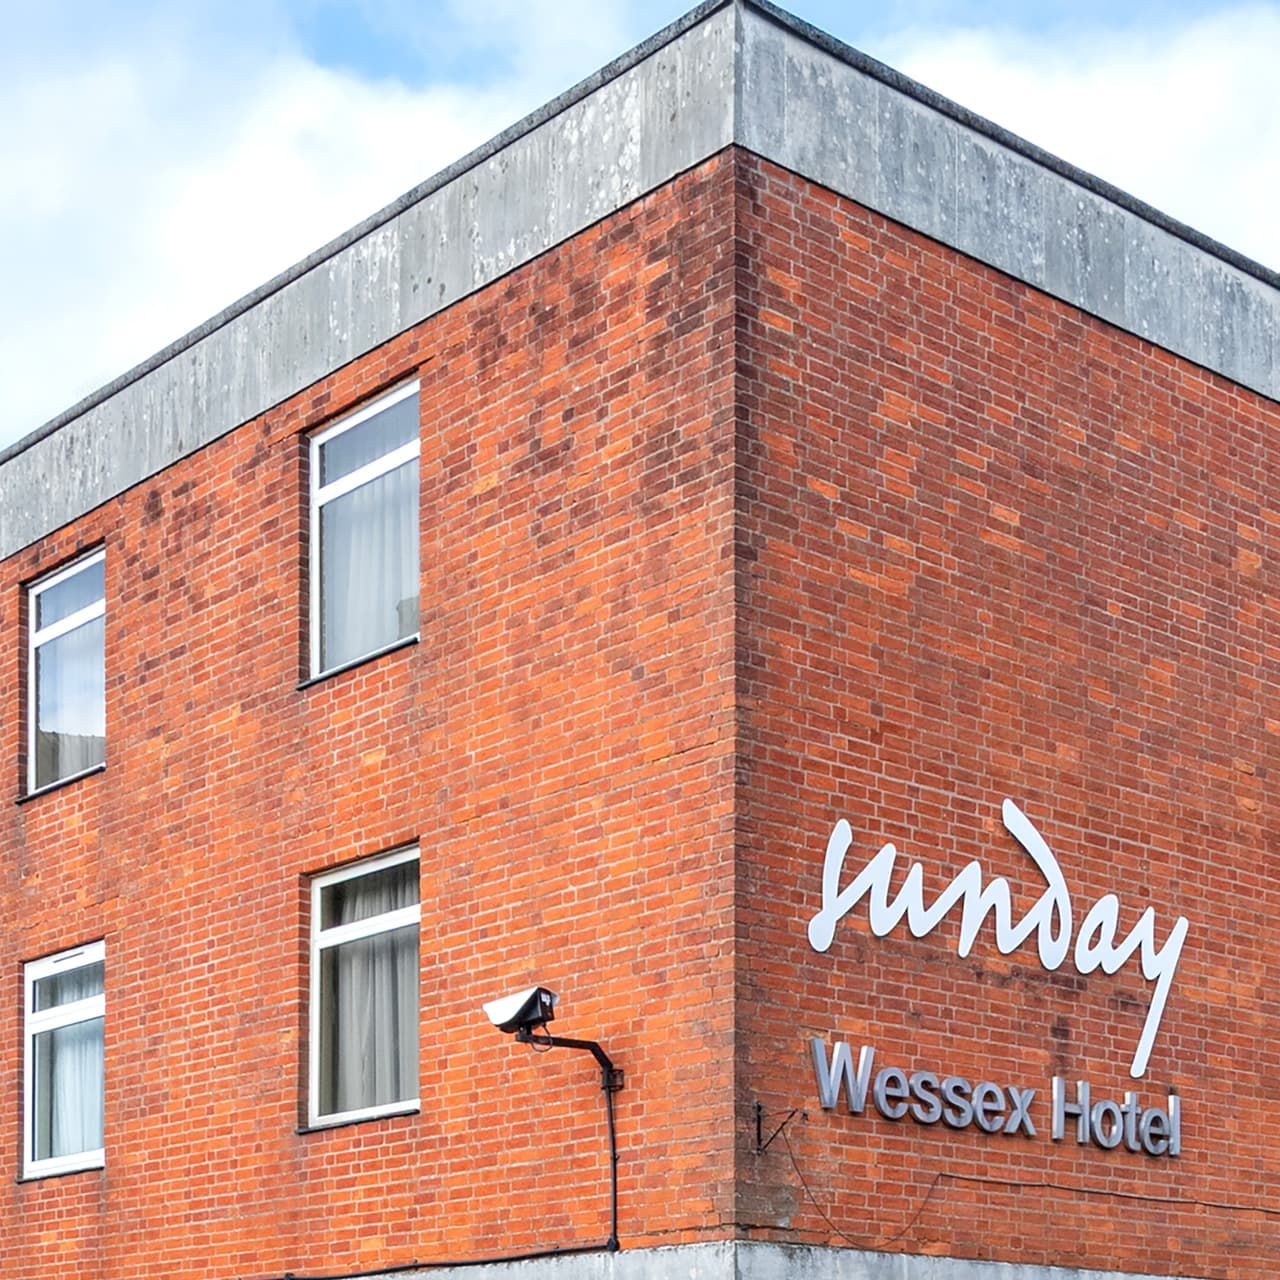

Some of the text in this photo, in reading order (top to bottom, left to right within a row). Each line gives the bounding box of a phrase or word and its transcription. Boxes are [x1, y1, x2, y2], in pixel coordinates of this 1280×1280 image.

[808, 798, 1189, 1079] sunday
[810, 1037, 1181, 1157] Wessex Hotel
